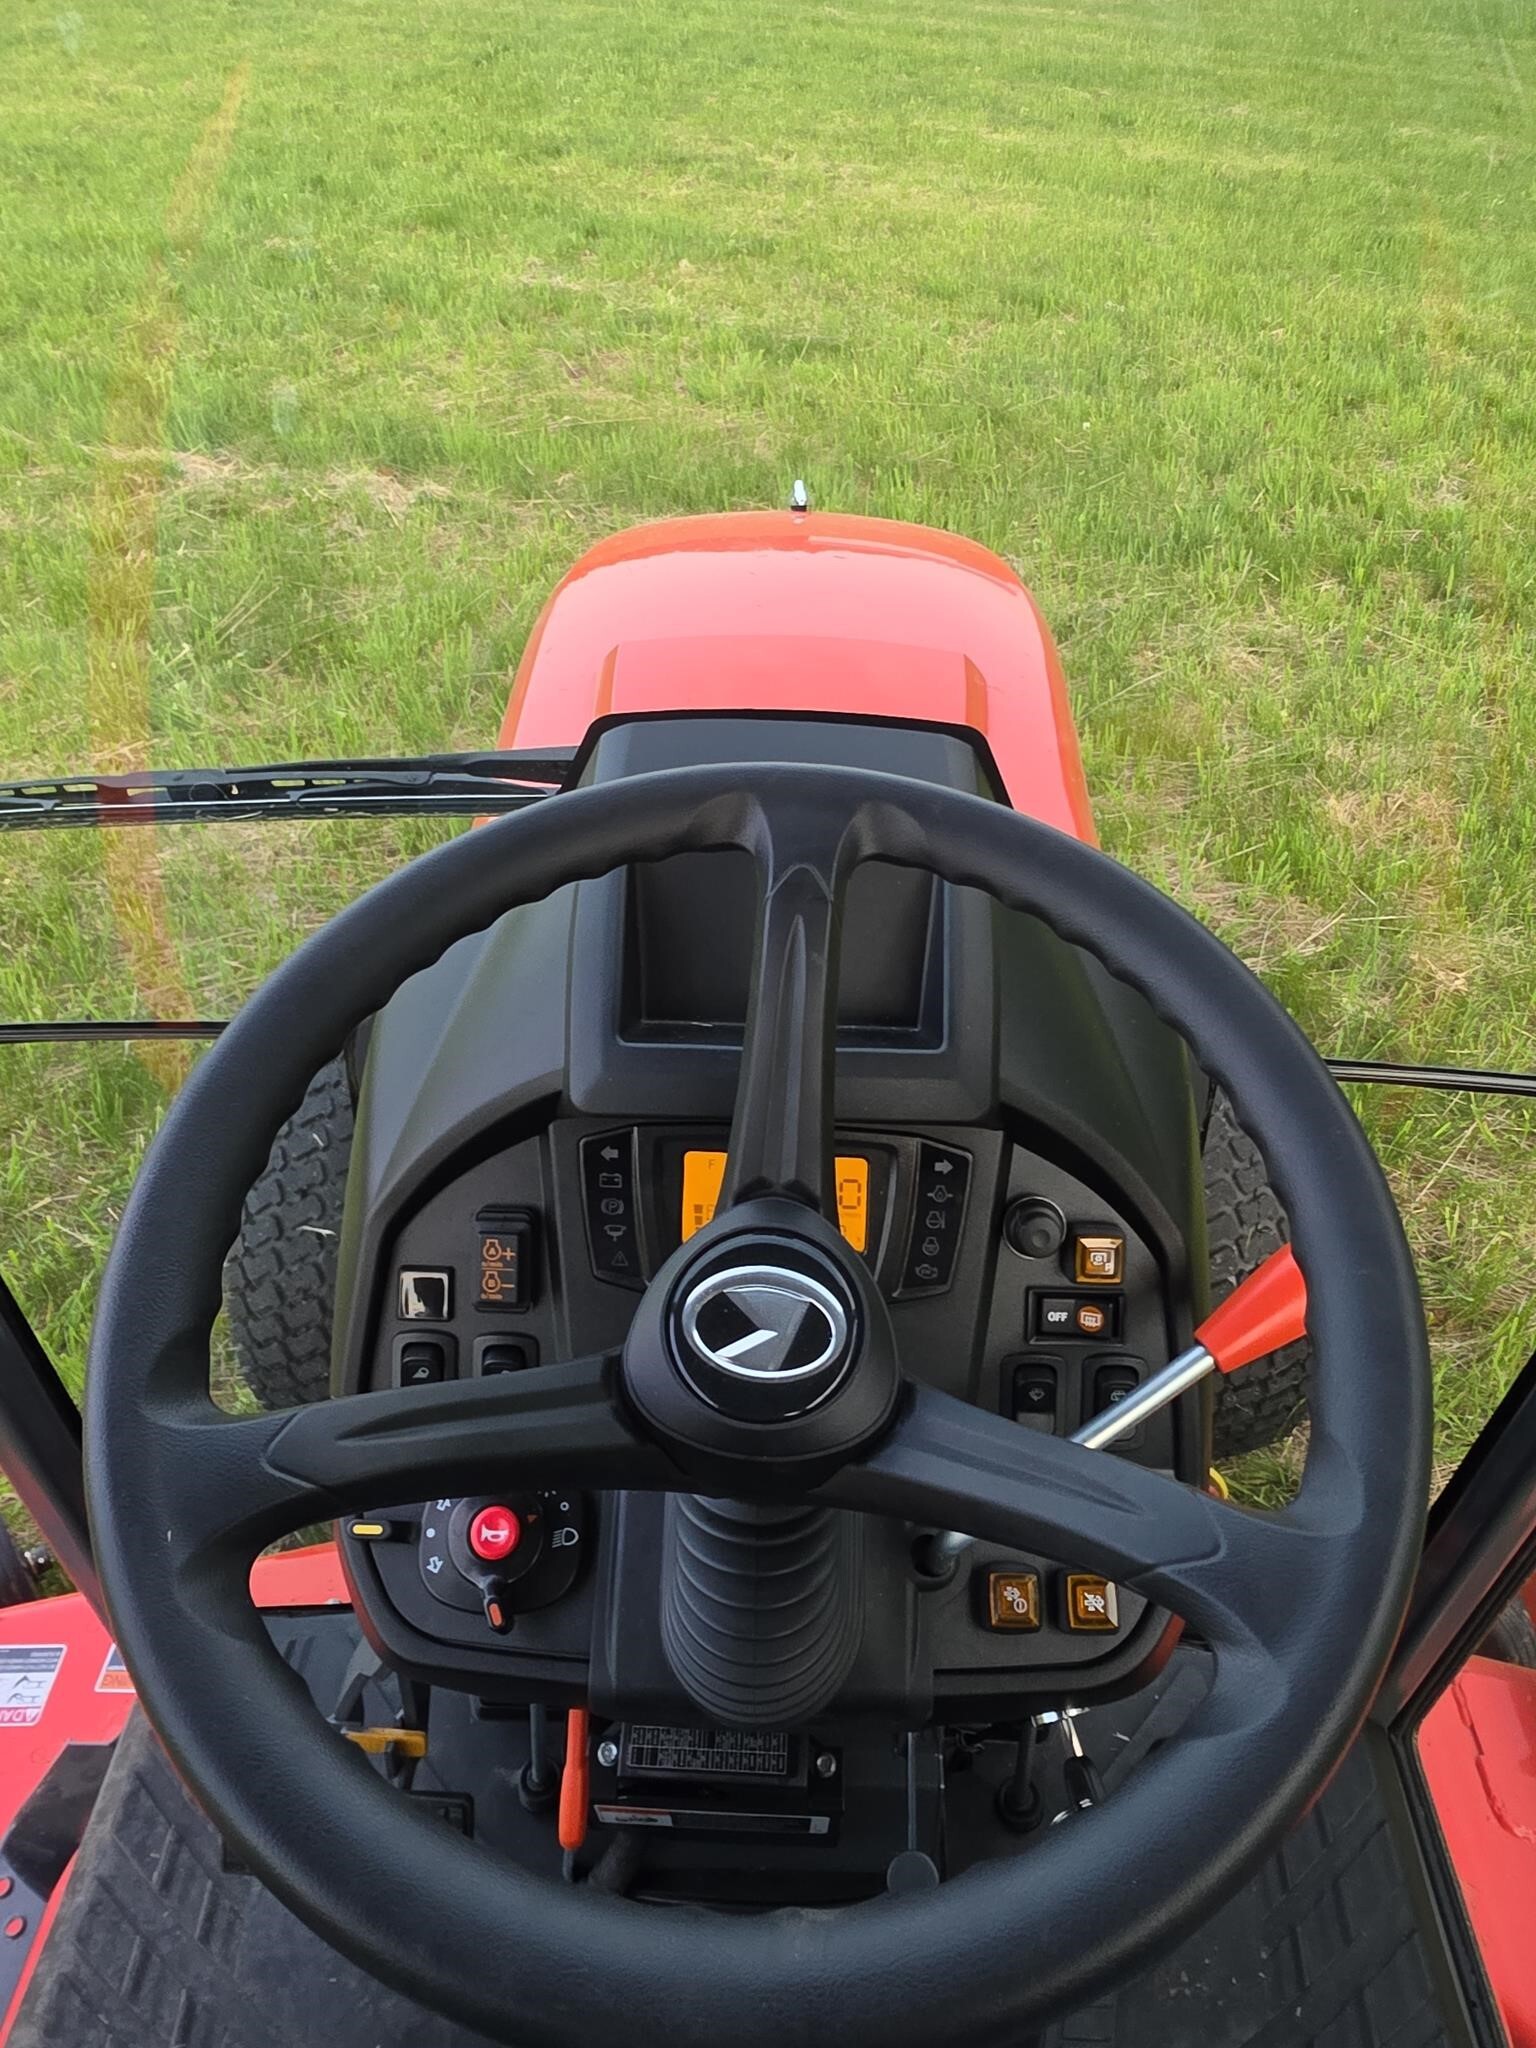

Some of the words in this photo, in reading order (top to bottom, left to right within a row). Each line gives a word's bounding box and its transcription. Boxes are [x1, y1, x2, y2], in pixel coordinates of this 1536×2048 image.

[839, 1179, 861, 1210] 0
[1047, 1311, 1069, 1322] OFF
[0, 1708, 25, 1722] DA
